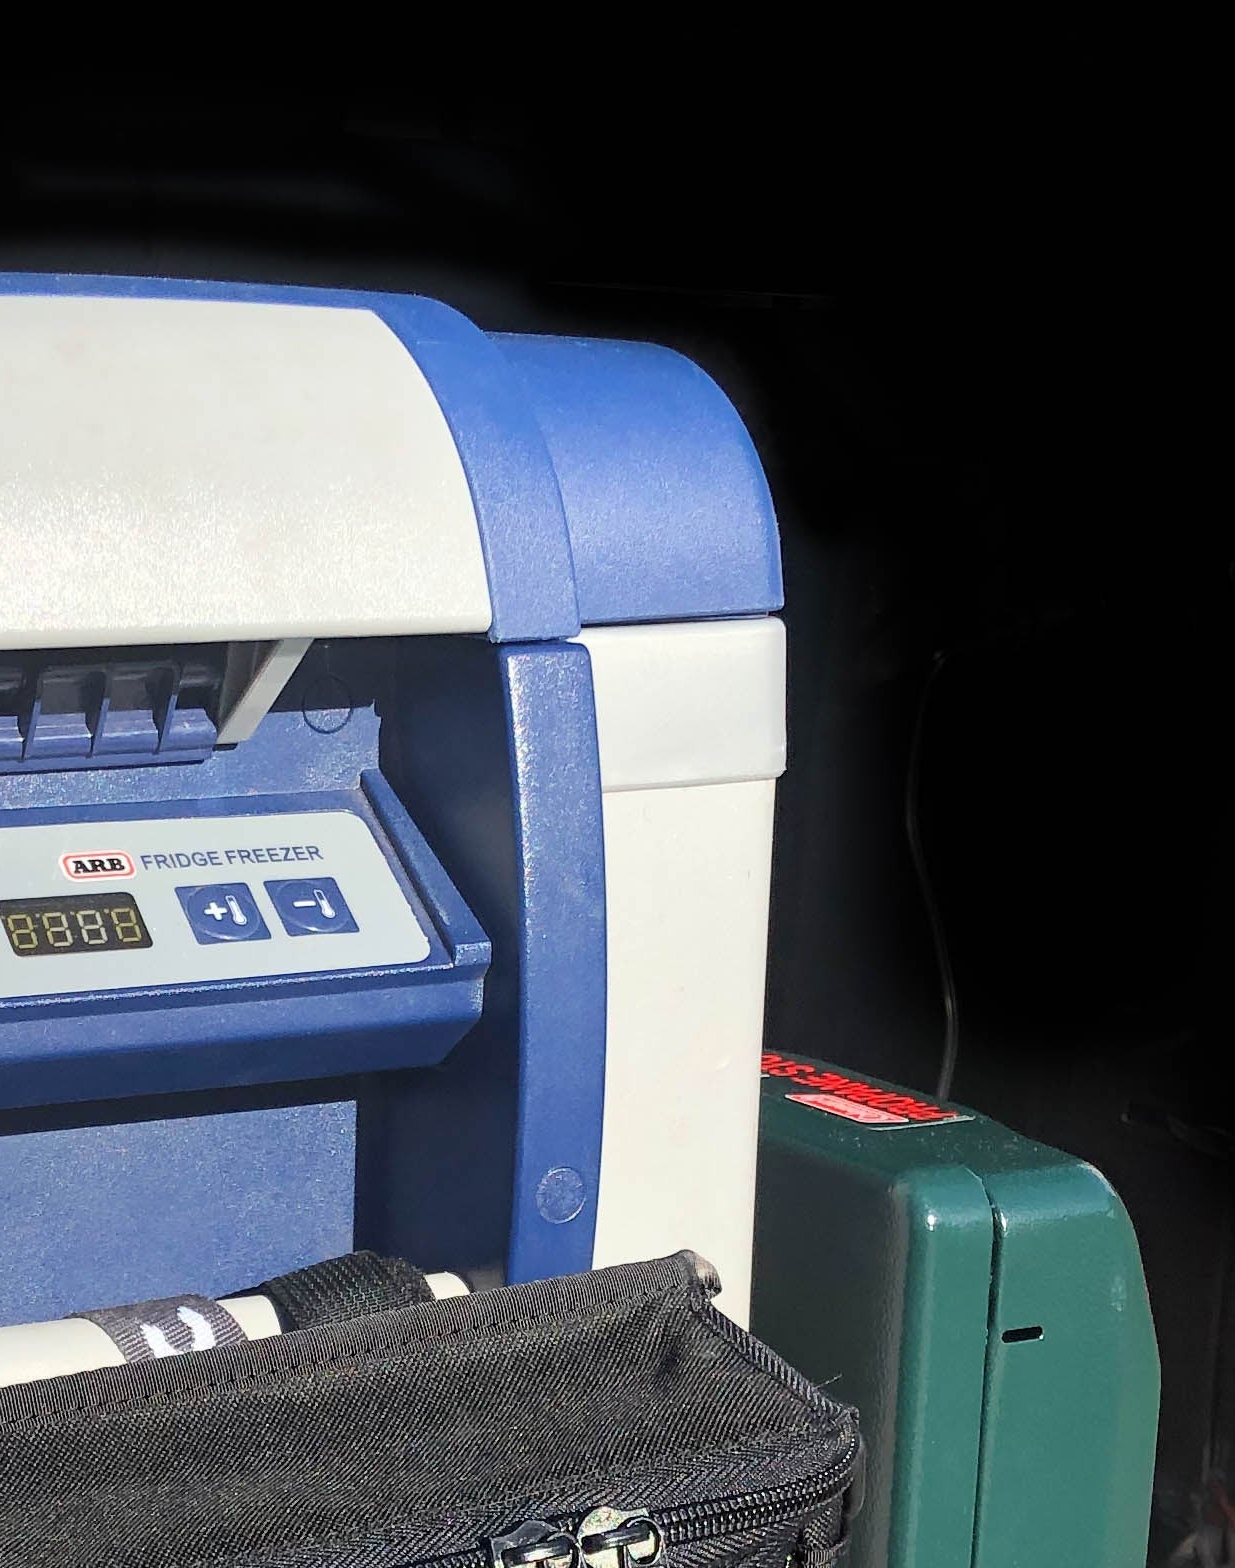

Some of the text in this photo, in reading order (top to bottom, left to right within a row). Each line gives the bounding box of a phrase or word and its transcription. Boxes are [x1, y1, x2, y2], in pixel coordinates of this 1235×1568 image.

[73, 845, 324, 876] ARB FRIDGE FREEZER
